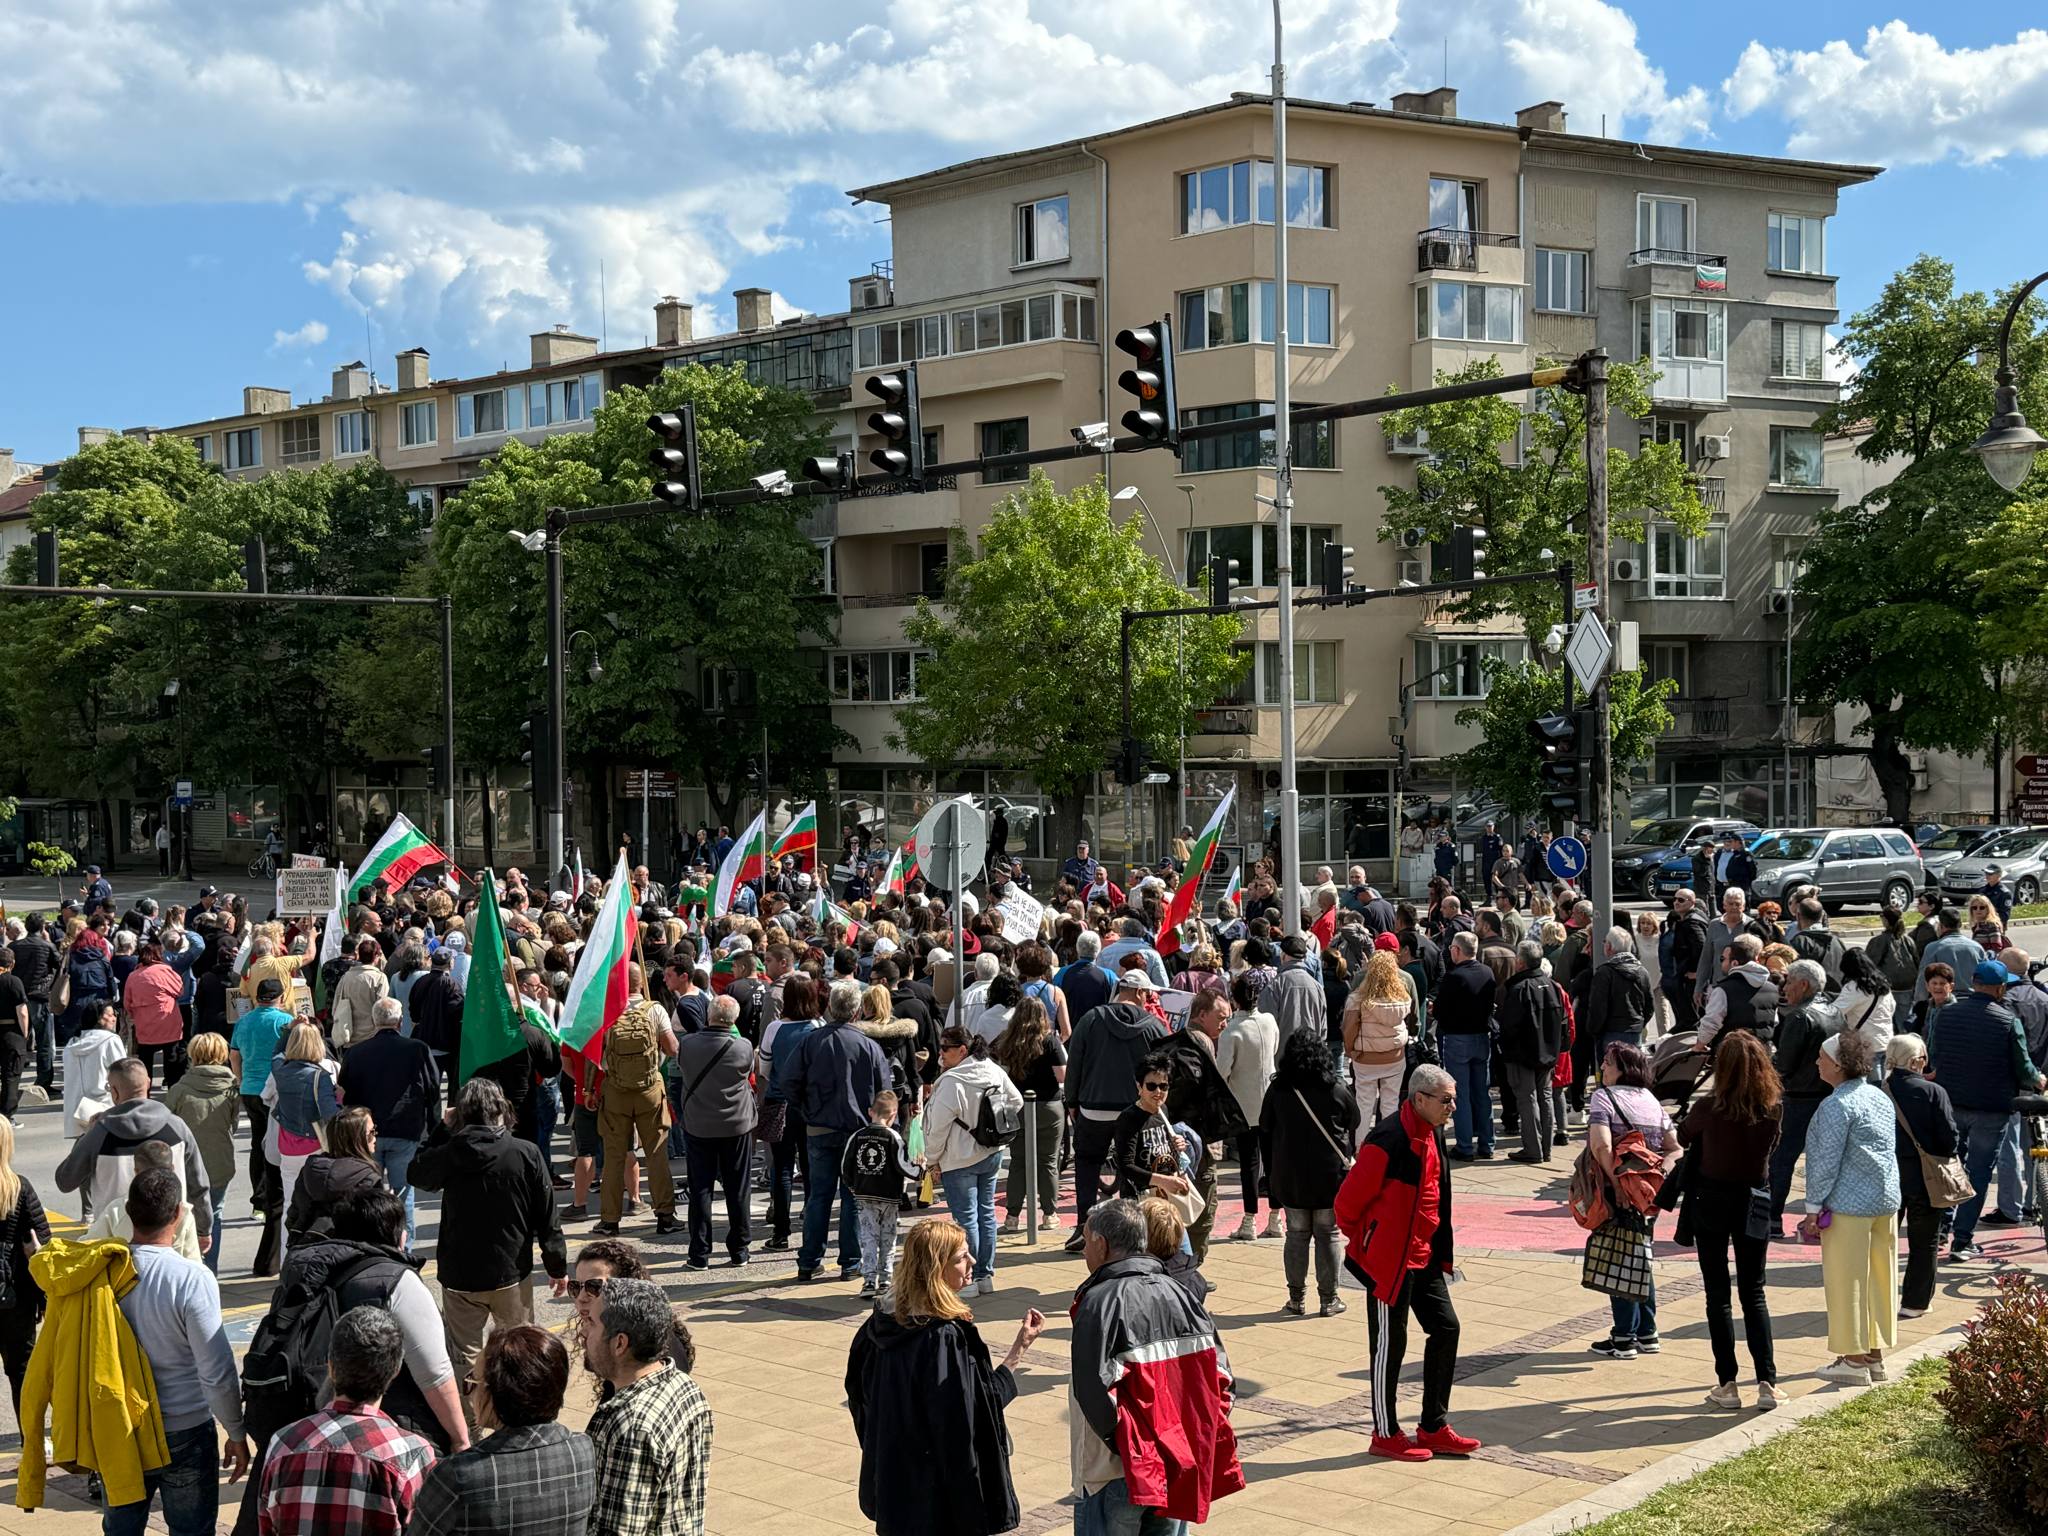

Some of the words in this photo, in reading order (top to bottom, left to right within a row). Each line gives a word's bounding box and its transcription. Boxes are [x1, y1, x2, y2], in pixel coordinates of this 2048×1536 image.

[291, 892, 315, 900] ДЕЦАТА
[319, 891, 329, 899] НА
[287, 899, 304, 907] СВОЯ
